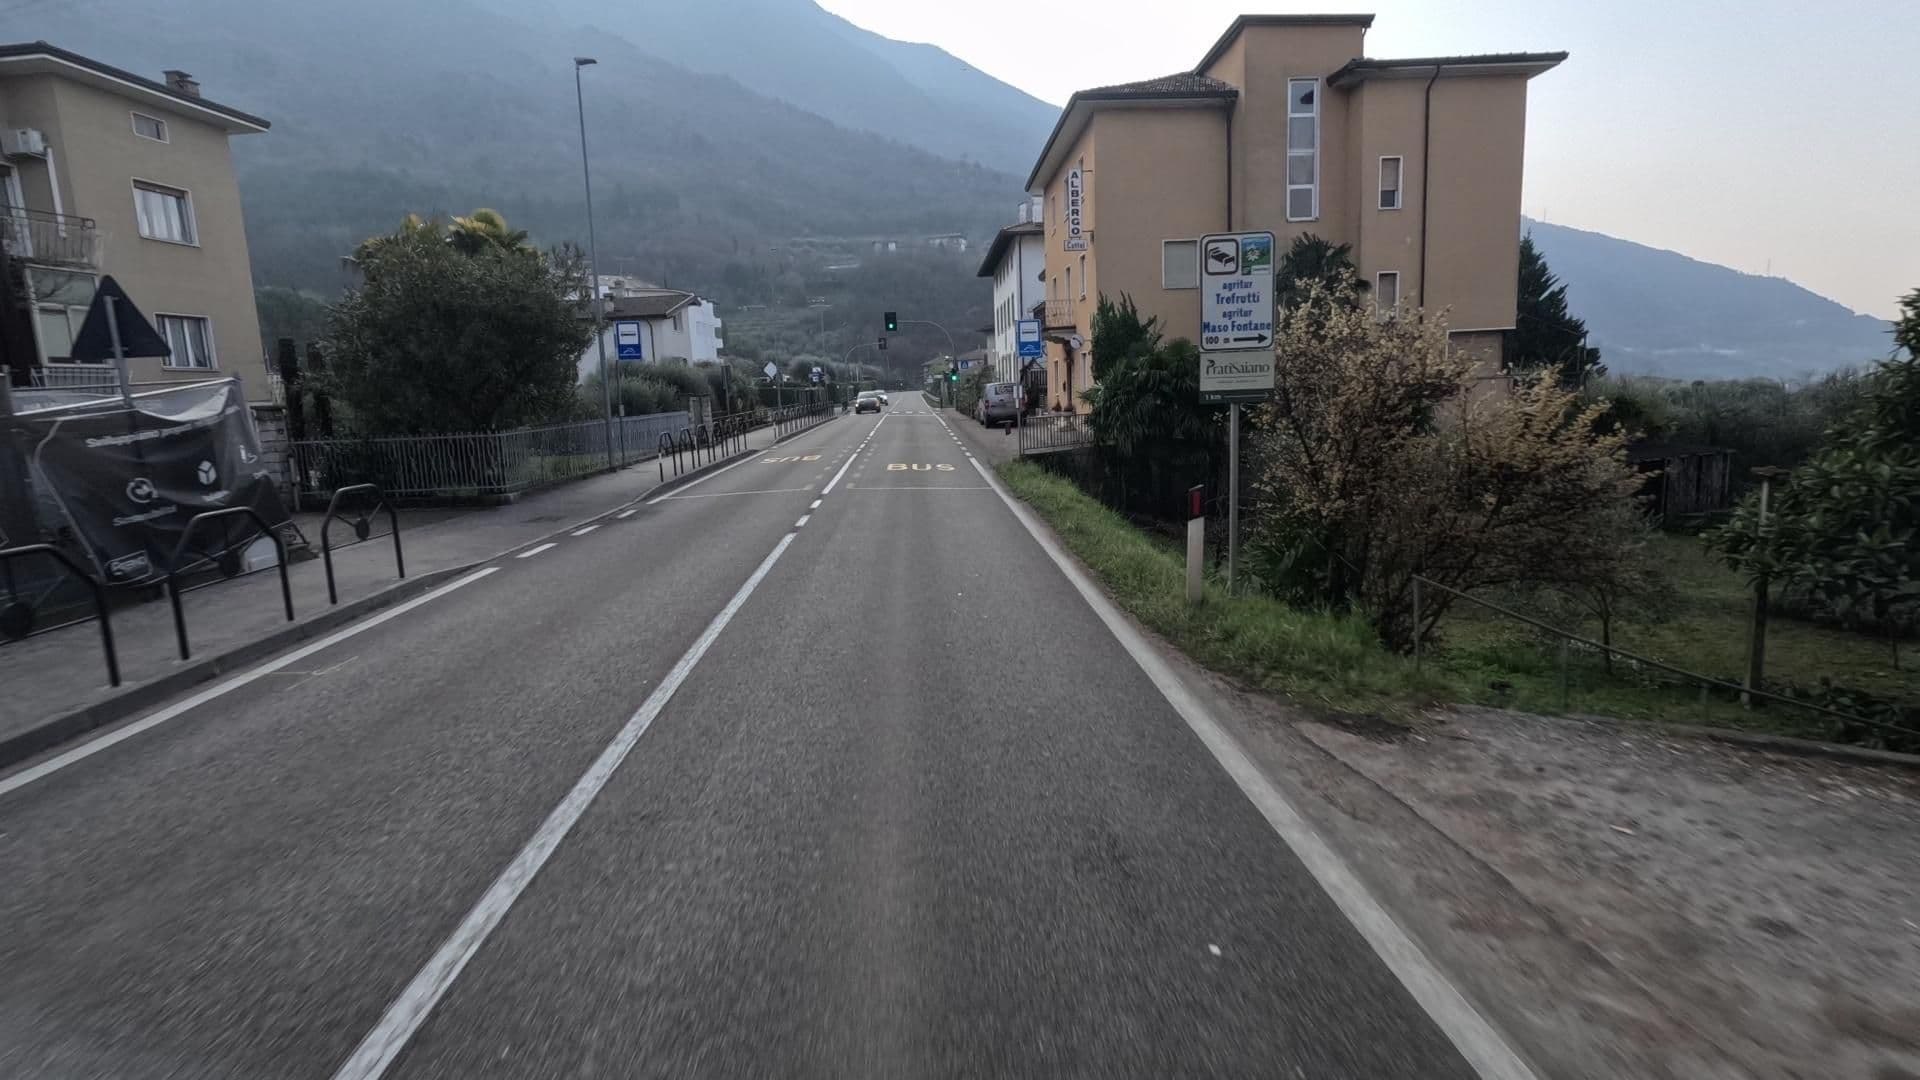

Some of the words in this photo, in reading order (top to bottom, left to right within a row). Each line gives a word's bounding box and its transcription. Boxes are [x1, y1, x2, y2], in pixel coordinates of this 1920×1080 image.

[1071, 171, 1080, 235] ALBERGO
[1222, 280, 1253, 291] agritur
[1216, 292, 1260, 305] Trefrutti
[1222, 308, 1253, 320] agritur
[1203, 321, 1229, 333] Maso
[1231, 320, 1272, 332] Fontane
[1205, 336, 1220, 345] 100
[886, 463, 956, 471] BUS
